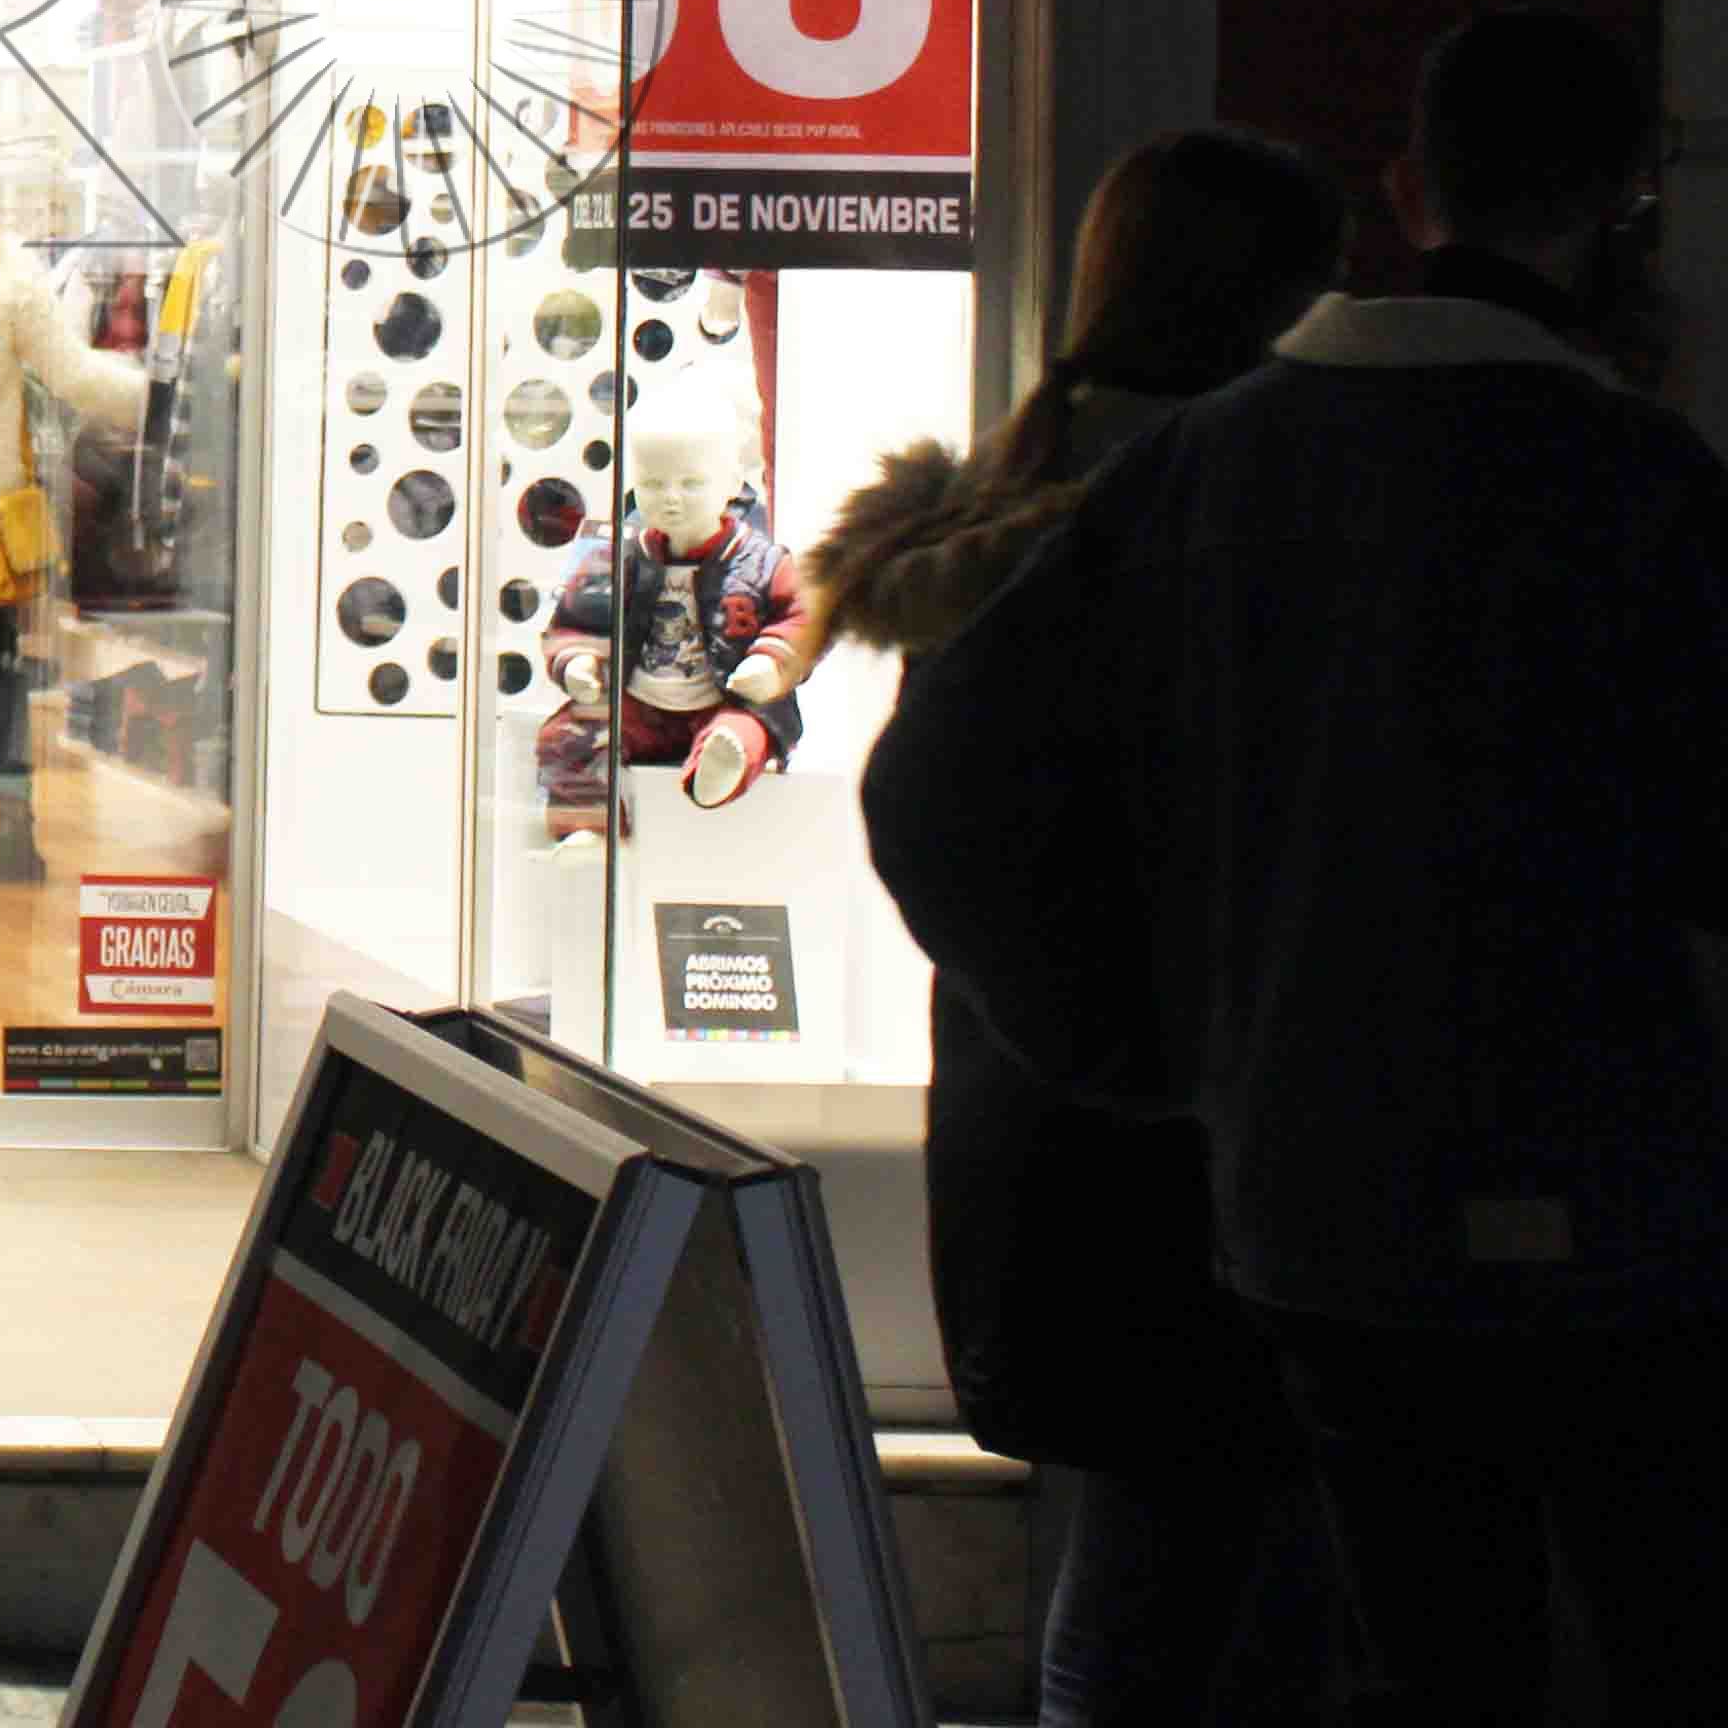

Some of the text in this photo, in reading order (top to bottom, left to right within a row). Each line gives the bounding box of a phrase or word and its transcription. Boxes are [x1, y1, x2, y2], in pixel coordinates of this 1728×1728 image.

[628, 193, 673, 230] 25
[693, 194, 741, 231] DE
[750, 194, 961, 234] NOVIEMBRE
[100, 925, 196, 969] GRACIAS
[685, 954, 769, 973] ABRIMOS
[684, 993, 777, 1011] DOMINGO
[332, 1128, 551, 1352] BLACK FRIDAY
[253, 1357, 422, 1627] TODO
